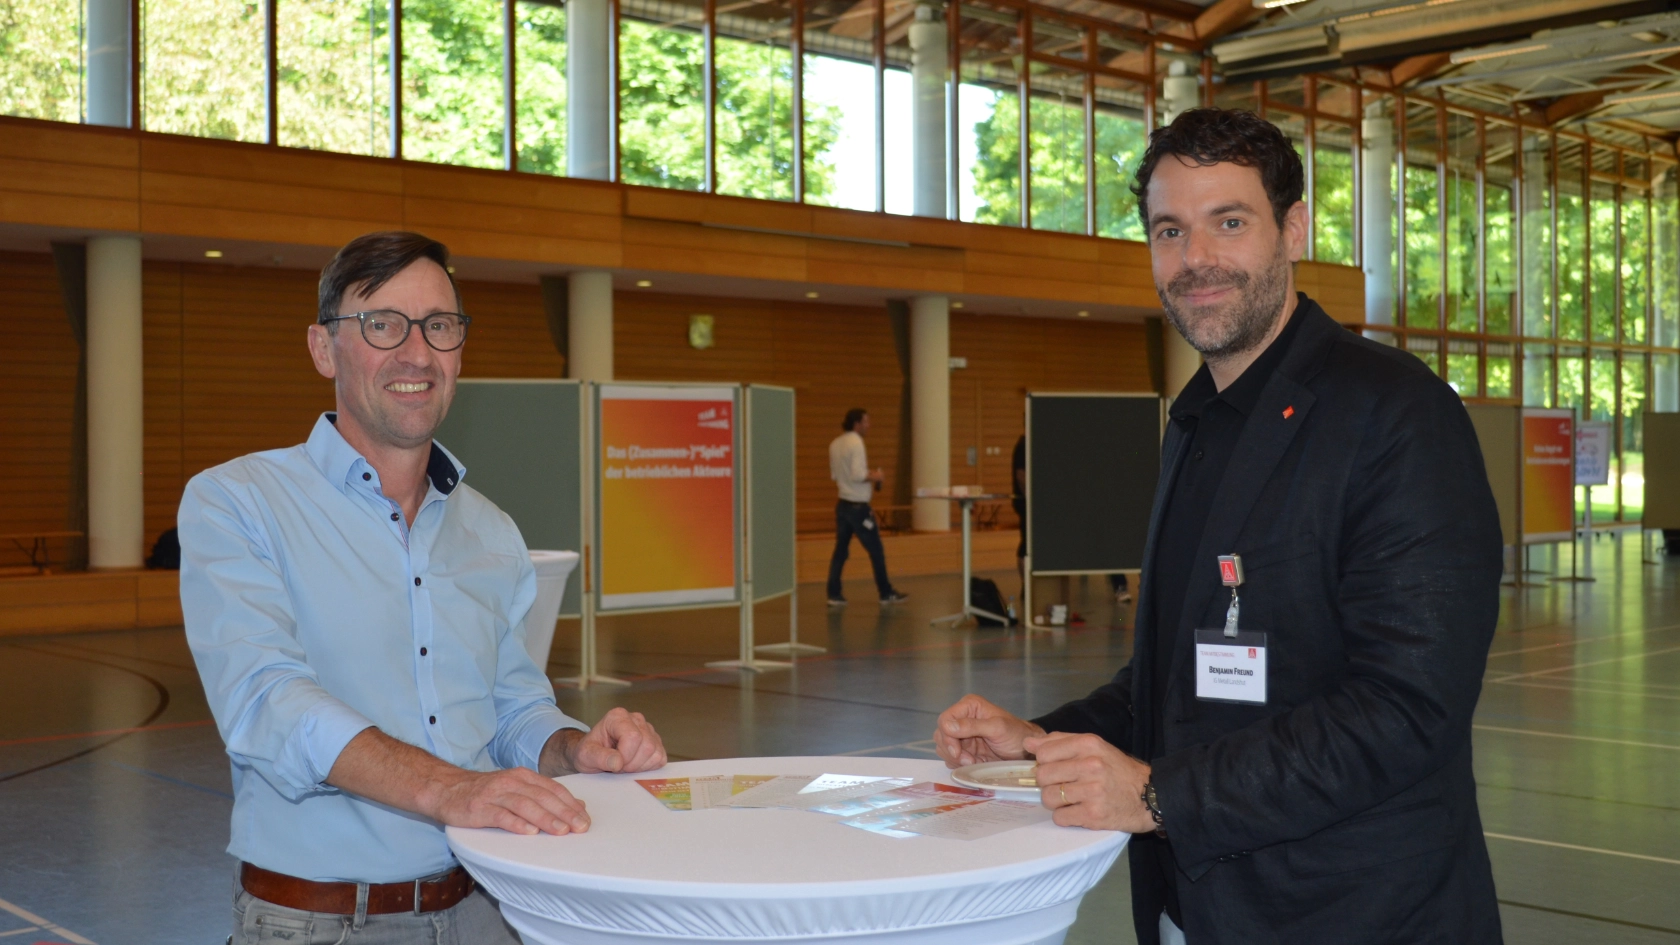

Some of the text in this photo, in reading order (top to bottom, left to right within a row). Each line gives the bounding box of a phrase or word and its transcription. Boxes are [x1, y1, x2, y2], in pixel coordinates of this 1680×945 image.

[607, 445, 626, 459] Das
[605, 465, 731, 479] der betrieblichen Akteure
[1209, 666, 1253, 676] BENJAMIN FREUND
